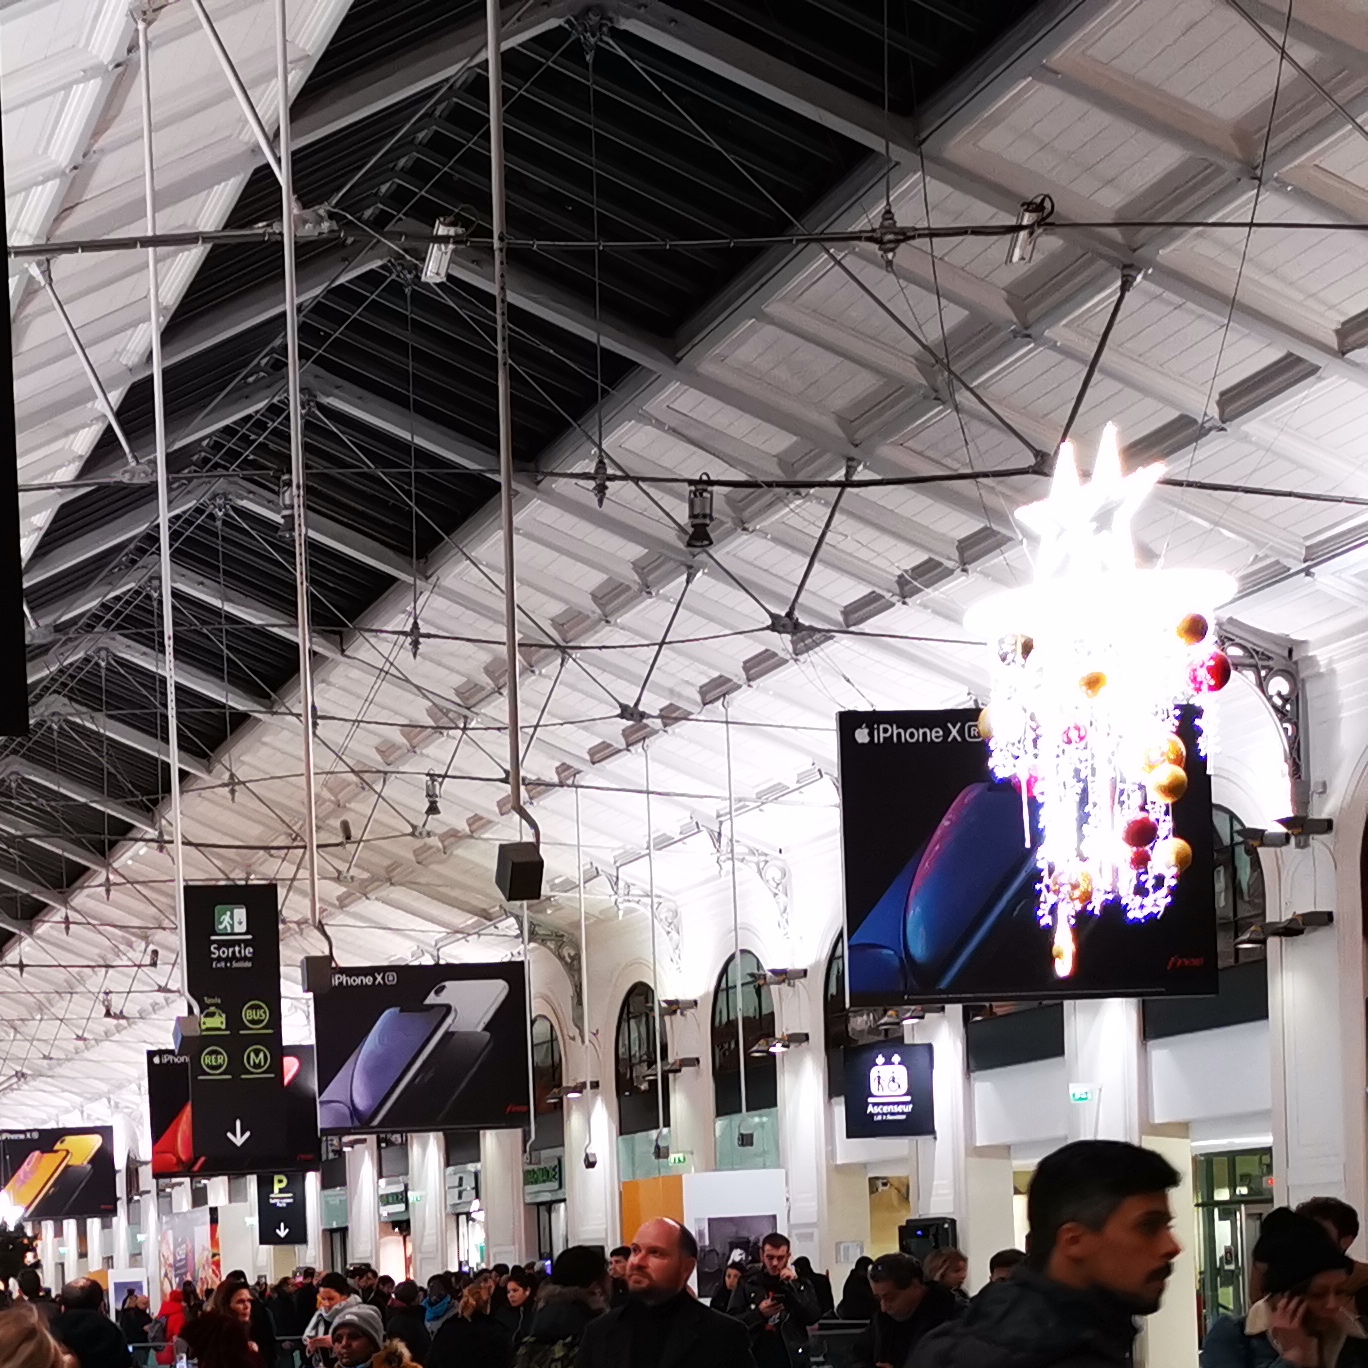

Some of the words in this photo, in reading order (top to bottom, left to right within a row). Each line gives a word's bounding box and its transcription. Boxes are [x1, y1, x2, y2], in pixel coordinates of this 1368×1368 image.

[873, 723, 944, 744] iPhone
[210, 943, 254, 958] Sortie
[331, 973, 373, 986] iPhone
[246, 1009, 267, 1020] BUS
[161, 1054, 190, 1064] iPhon
[204, 1054, 224, 1066] RER
[250, 1051, 264, 1066] M
[866, 1103, 913, 1115] Ascenseur
[273, 1174, 288, 1194] P
